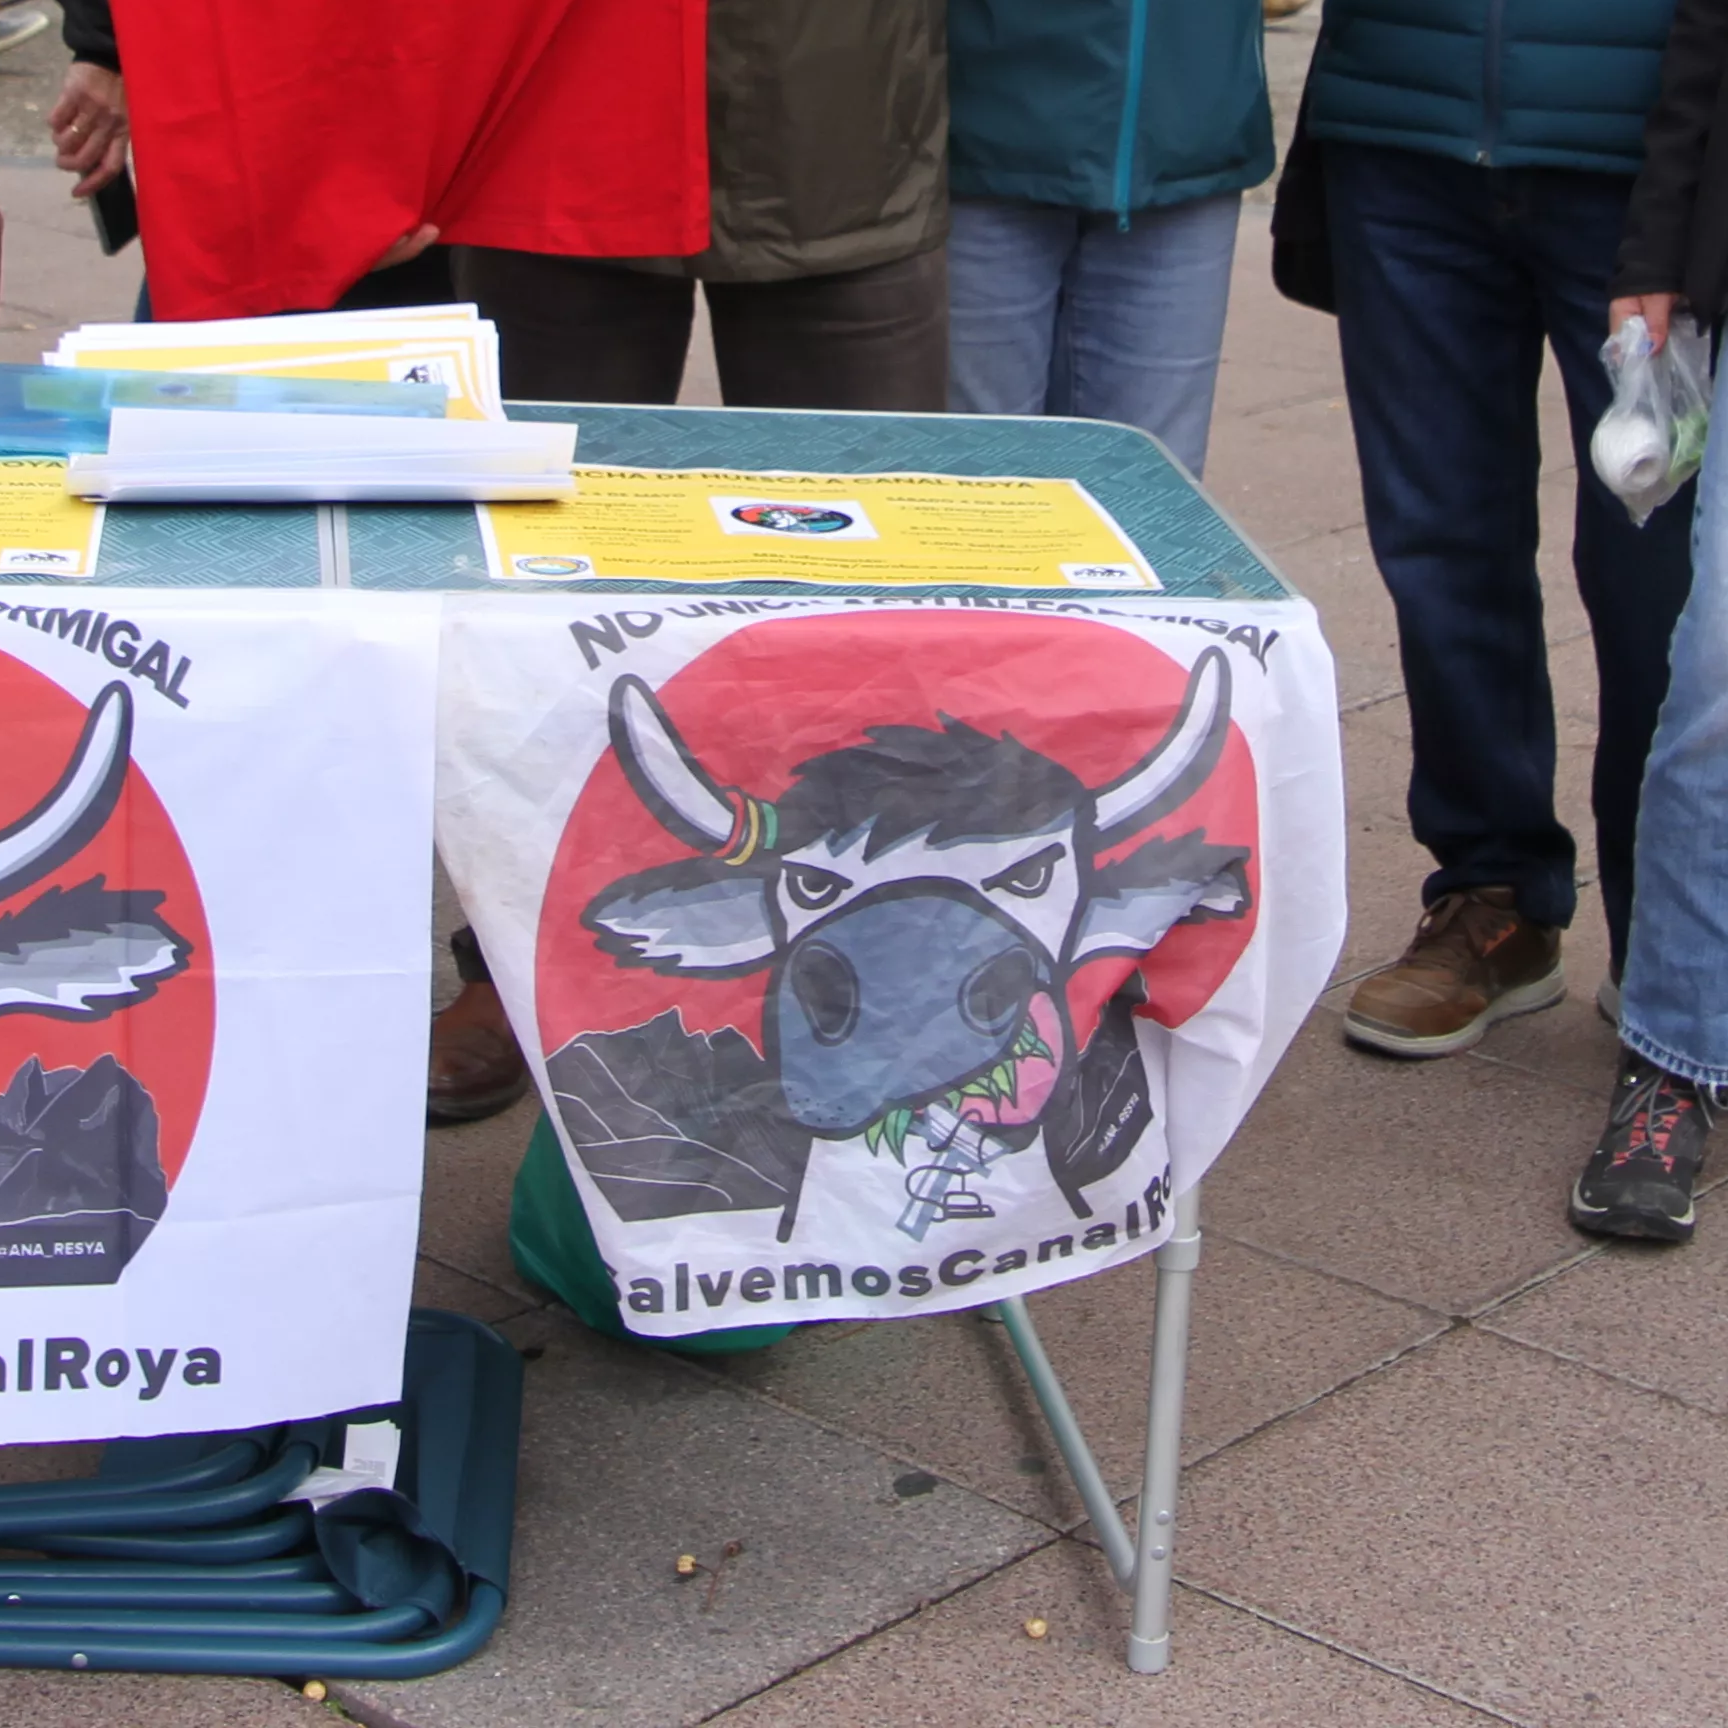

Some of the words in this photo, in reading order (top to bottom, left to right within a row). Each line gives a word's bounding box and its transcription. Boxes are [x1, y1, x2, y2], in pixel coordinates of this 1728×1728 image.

[656, 472, 693, 481] DE
[700, 472, 819, 484] HUESCA
[825, 477, 845, 485] A
[853, 477, 950, 486] CANAL
[956, 480, 1036, 489] ROYA
[568, 610, 664, 672] NO
